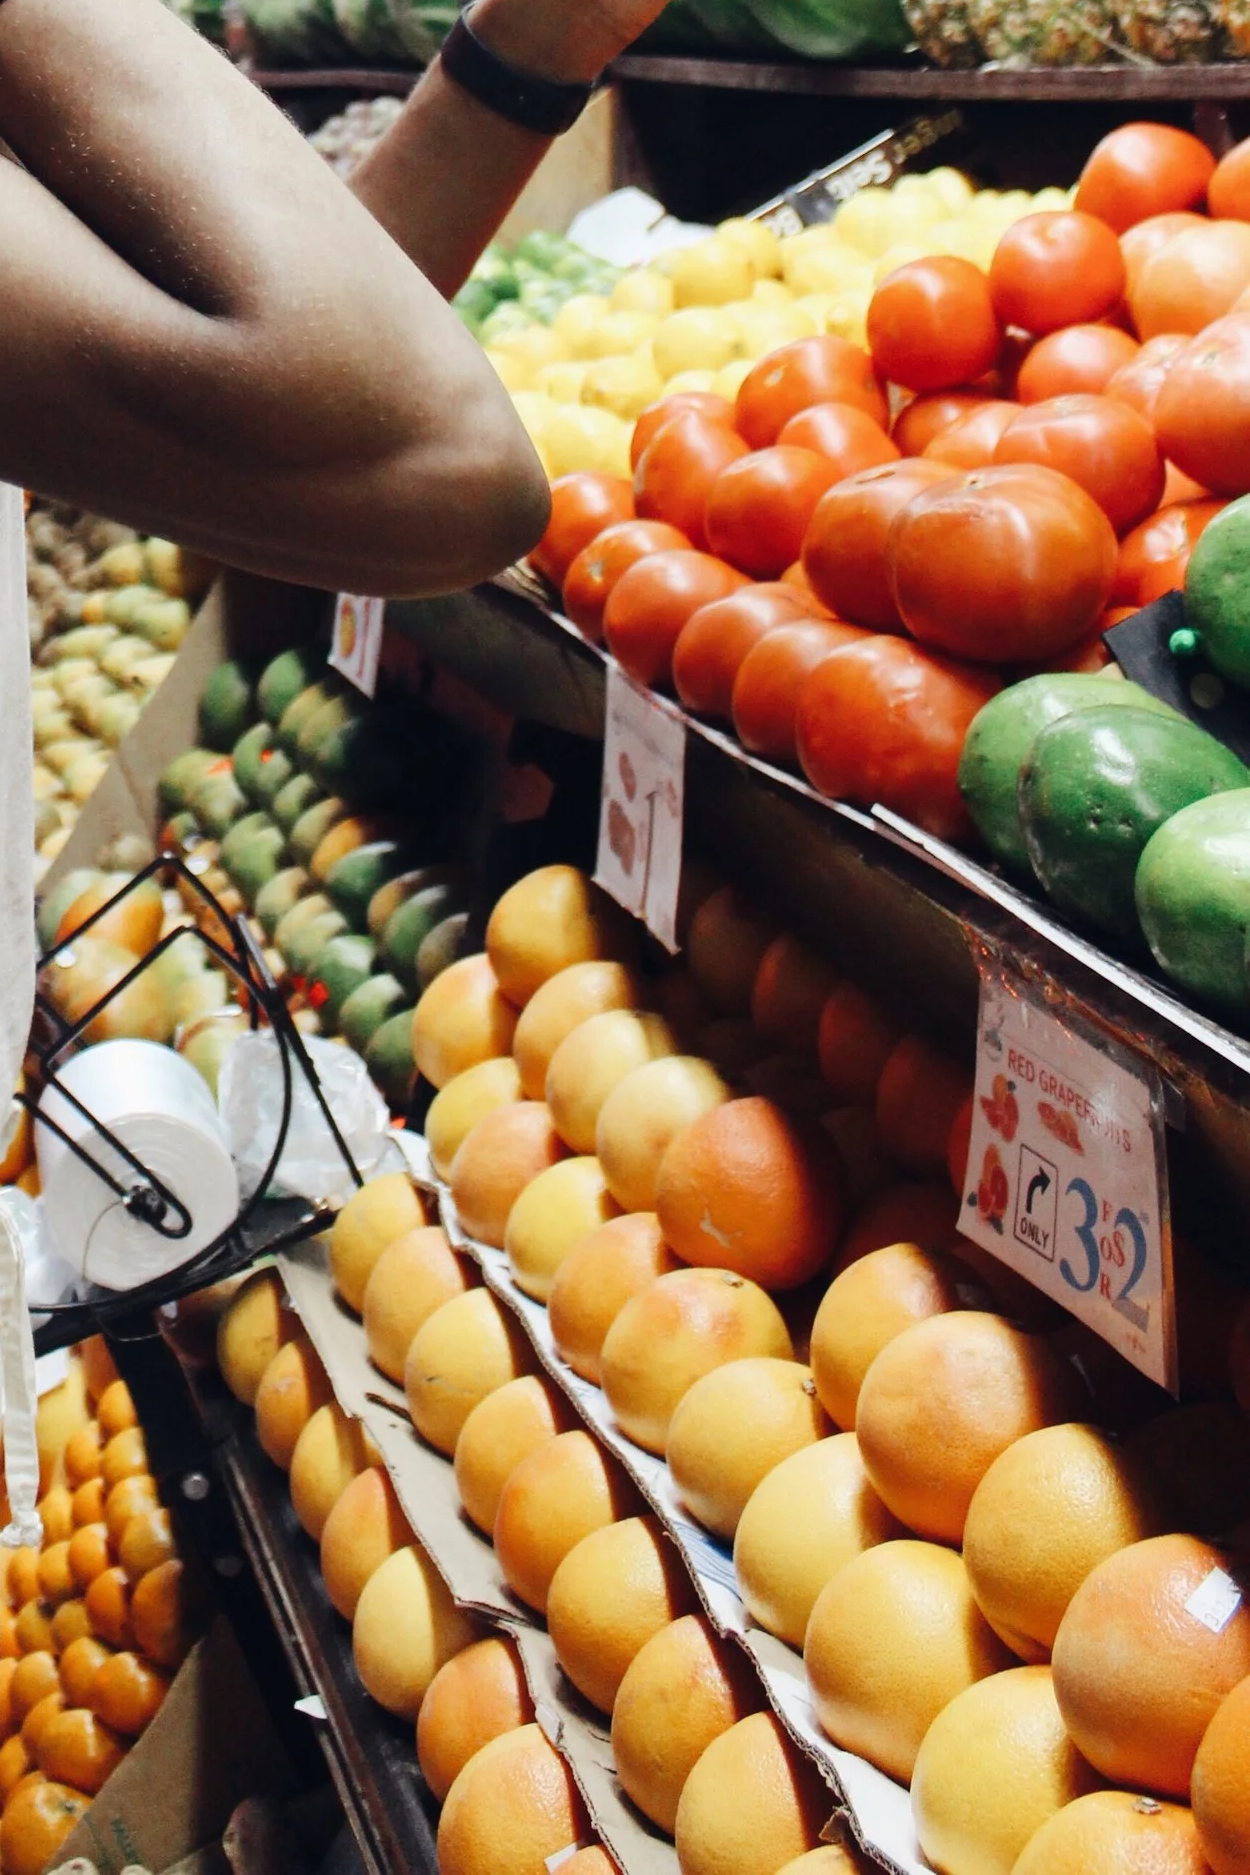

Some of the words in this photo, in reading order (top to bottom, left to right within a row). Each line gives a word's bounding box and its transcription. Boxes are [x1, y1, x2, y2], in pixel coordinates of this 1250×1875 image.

[1007, 1048, 1036, 1084] RED
[1019, 1216, 1050, 1251] ONLY
[1058, 1176, 1101, 1293] 3
